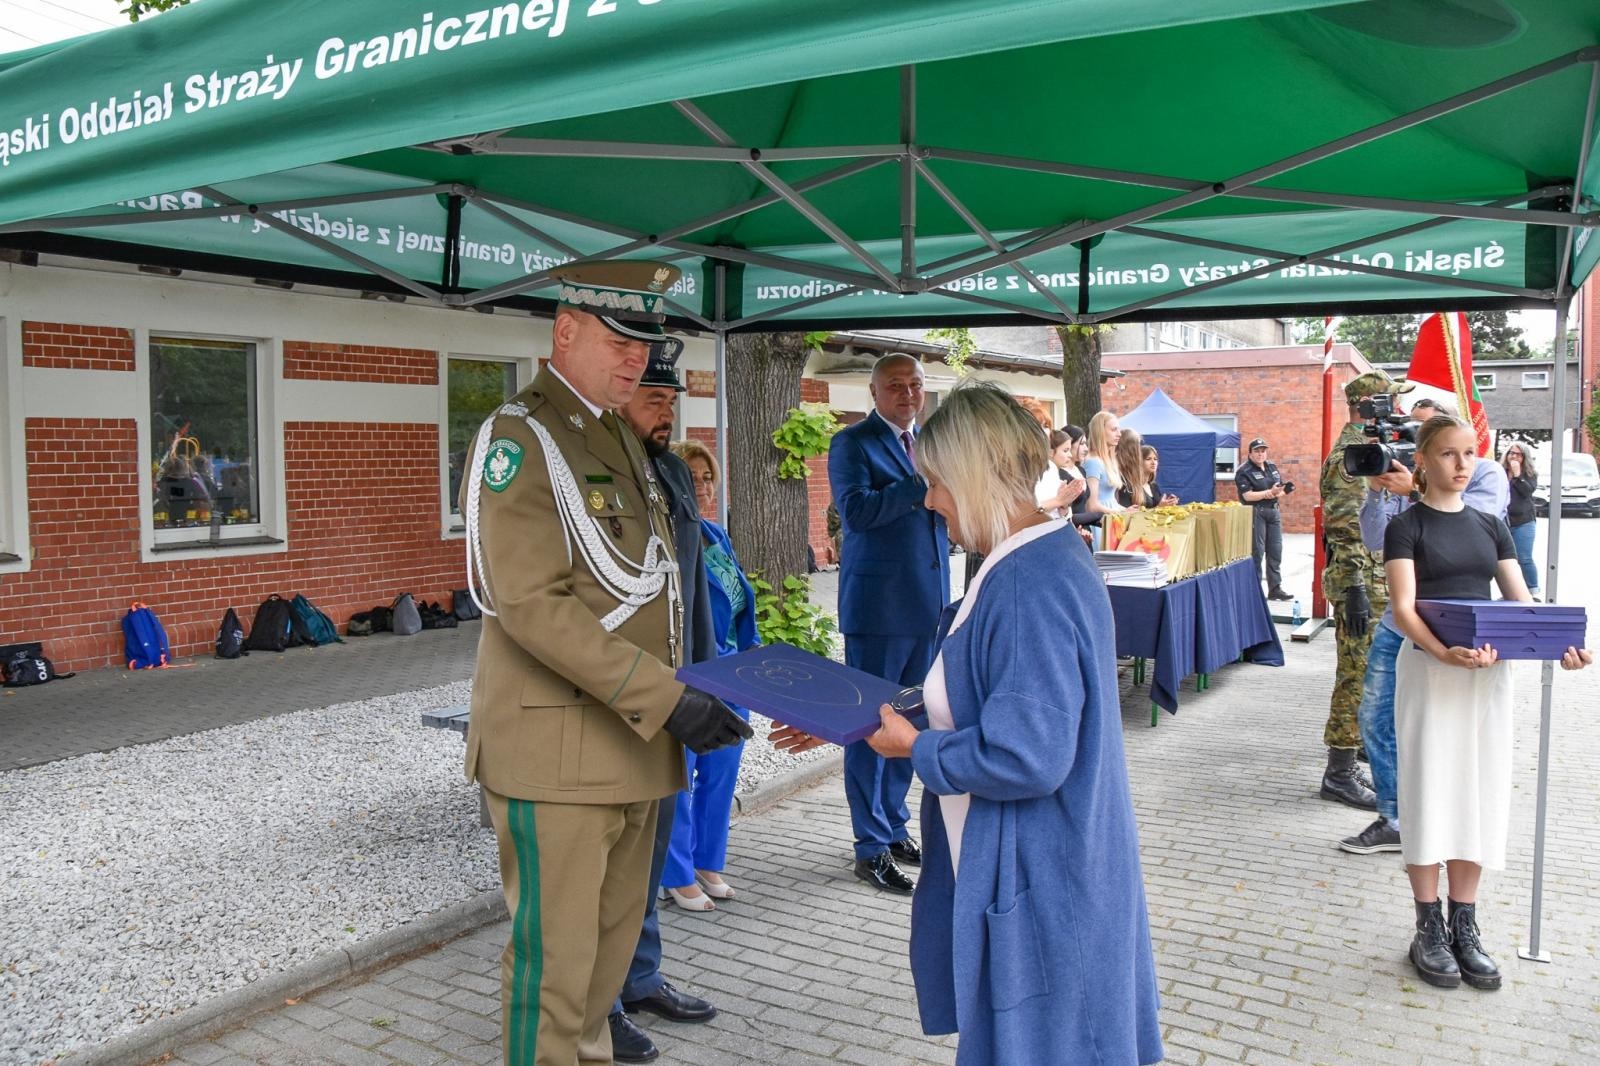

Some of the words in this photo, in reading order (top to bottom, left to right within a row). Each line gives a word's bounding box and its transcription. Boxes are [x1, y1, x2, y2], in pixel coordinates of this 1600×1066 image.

[59, 82, 174, 145] Oddział
[184, 55, 303, 114] Straży
[314, 0, 569, 80] Granicznej
